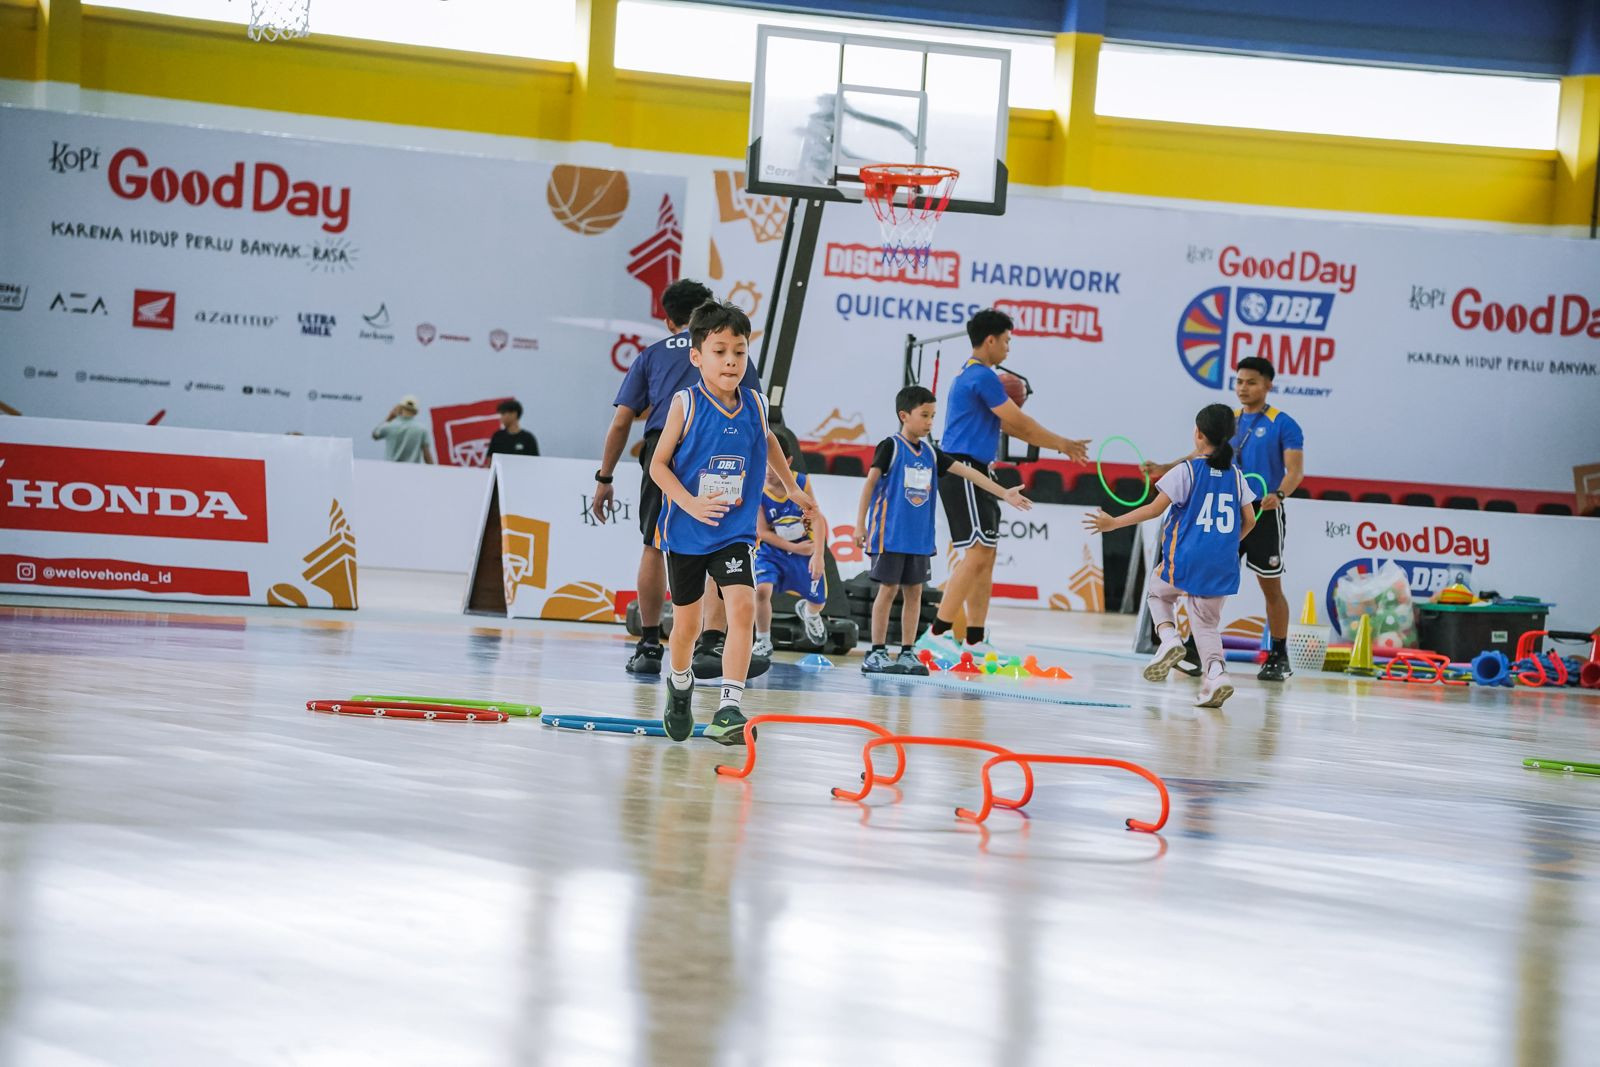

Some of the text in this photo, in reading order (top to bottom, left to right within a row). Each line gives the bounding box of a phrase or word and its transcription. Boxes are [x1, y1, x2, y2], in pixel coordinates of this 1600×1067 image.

[51, 221, 349, 264] KARENA HIDUP PERLU BANYAK RASA
[972, 261, 1120, 294] HARDWORK
[298, 312, 336, 327] ULTRA
[1266, 295, 1325, 325] DBL
[302, 325, 331, 338] MILK
[666, 337, 691, 349] CO
[1231, 332, 1335, 377] CAMP
[1408, 351, 1460, 367] KARENA
[1466, 356, 1502, 371] HIDUP
[1507, 357, 1544, 373] PERLU
[717, 460, 736, 470] DBL
[6, 478, 248, 521] HONDA
[1196, 493, 1235, 534] 45
